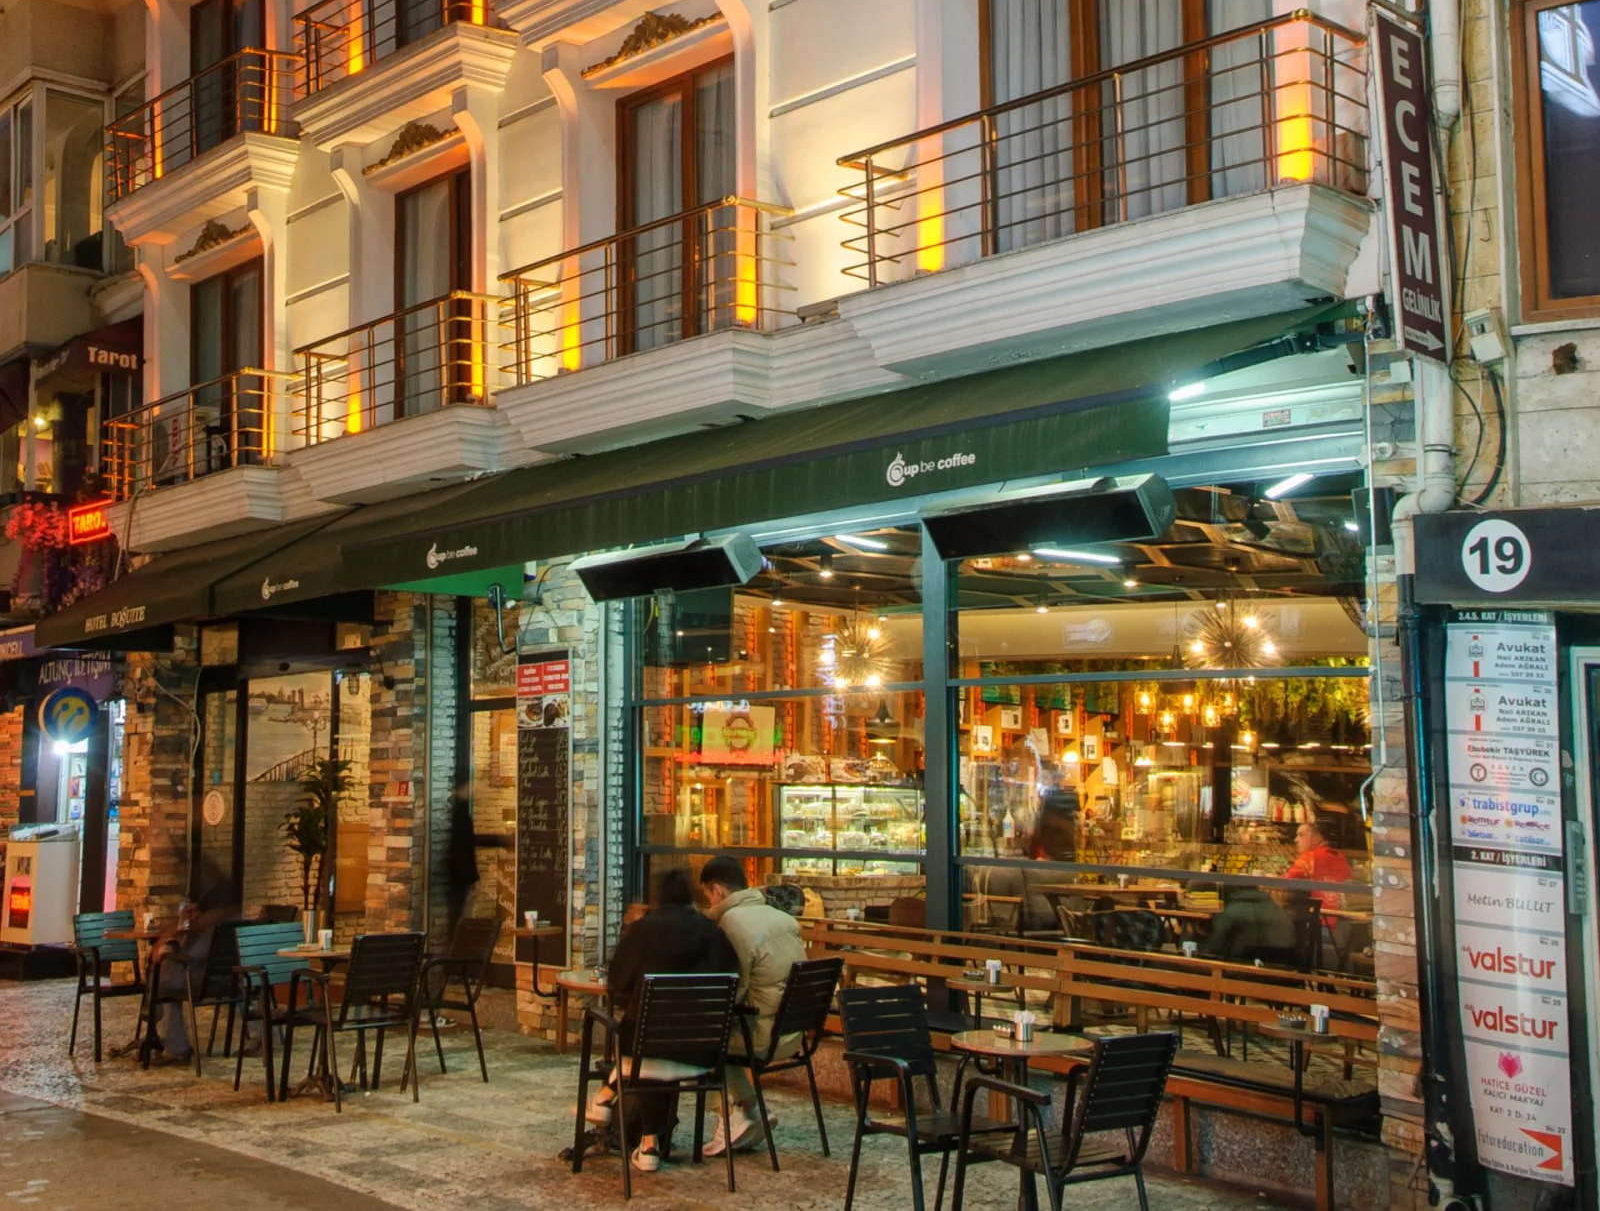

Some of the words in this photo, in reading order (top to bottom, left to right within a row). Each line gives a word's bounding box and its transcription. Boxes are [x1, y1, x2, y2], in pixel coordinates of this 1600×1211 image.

[1389, 33, 1433, 285] ECEM
[1402, 287, 1442, 324] GELİNLİK
[87, 346, 138, 370] Tarot
[920, 460, 936, 473] be
[937, 452, 976, 470] coffee
[73, 511, 106, 534] TARO
[456, 545, 478, 558] coffee
[1469, 536, 1524, 575] 19
[84, 614, 108, 633] HOTEL
[1481, 612, 1496, 621] KAT
[1503, 610, 1548, 623] İŞYERLERİ
[1496, 642, 1546, 654] Avukat
[1514, 655, 1546, 663] ARIKAN
[1518, 663, 1548, 671] AĞRALI
[38, 658, 73, 685] ALTUNÇ
[1498, 696, 1547, 708] Avukat
[1519, 717, 1550, 725] AĞRALI
[1467, 745, 1501, 754] Ebubekir
[1503, 746, 1551, 758] TAŞYÜREK
[1471, 850, 1480, 861] 2.
[1480, 851, 1495, 862] KAT
[1501, 851, 1547, 867] İŞYERLERİ
[1467, 892, 1504, 907] Metin
[1504, 897, 1555, 913] BULUT
[1469, 946, 1556, 979] valstur
[1471, 1005, 1558, 1040] valstur
[1480, 1077, 1511, 1091] HATİCE
[1514, 1083, 1547, 1097] GÜZEL
[1484, 1088, 1507, 1100] KALICI
[1509, 1095, 1545, 1107] MAKYAJ
[1507, 1109, 1512, 1117] 2
[1526, 1113, 1537, 1121] 24
[1478, 1128, 1545, 1158] Futureducation
